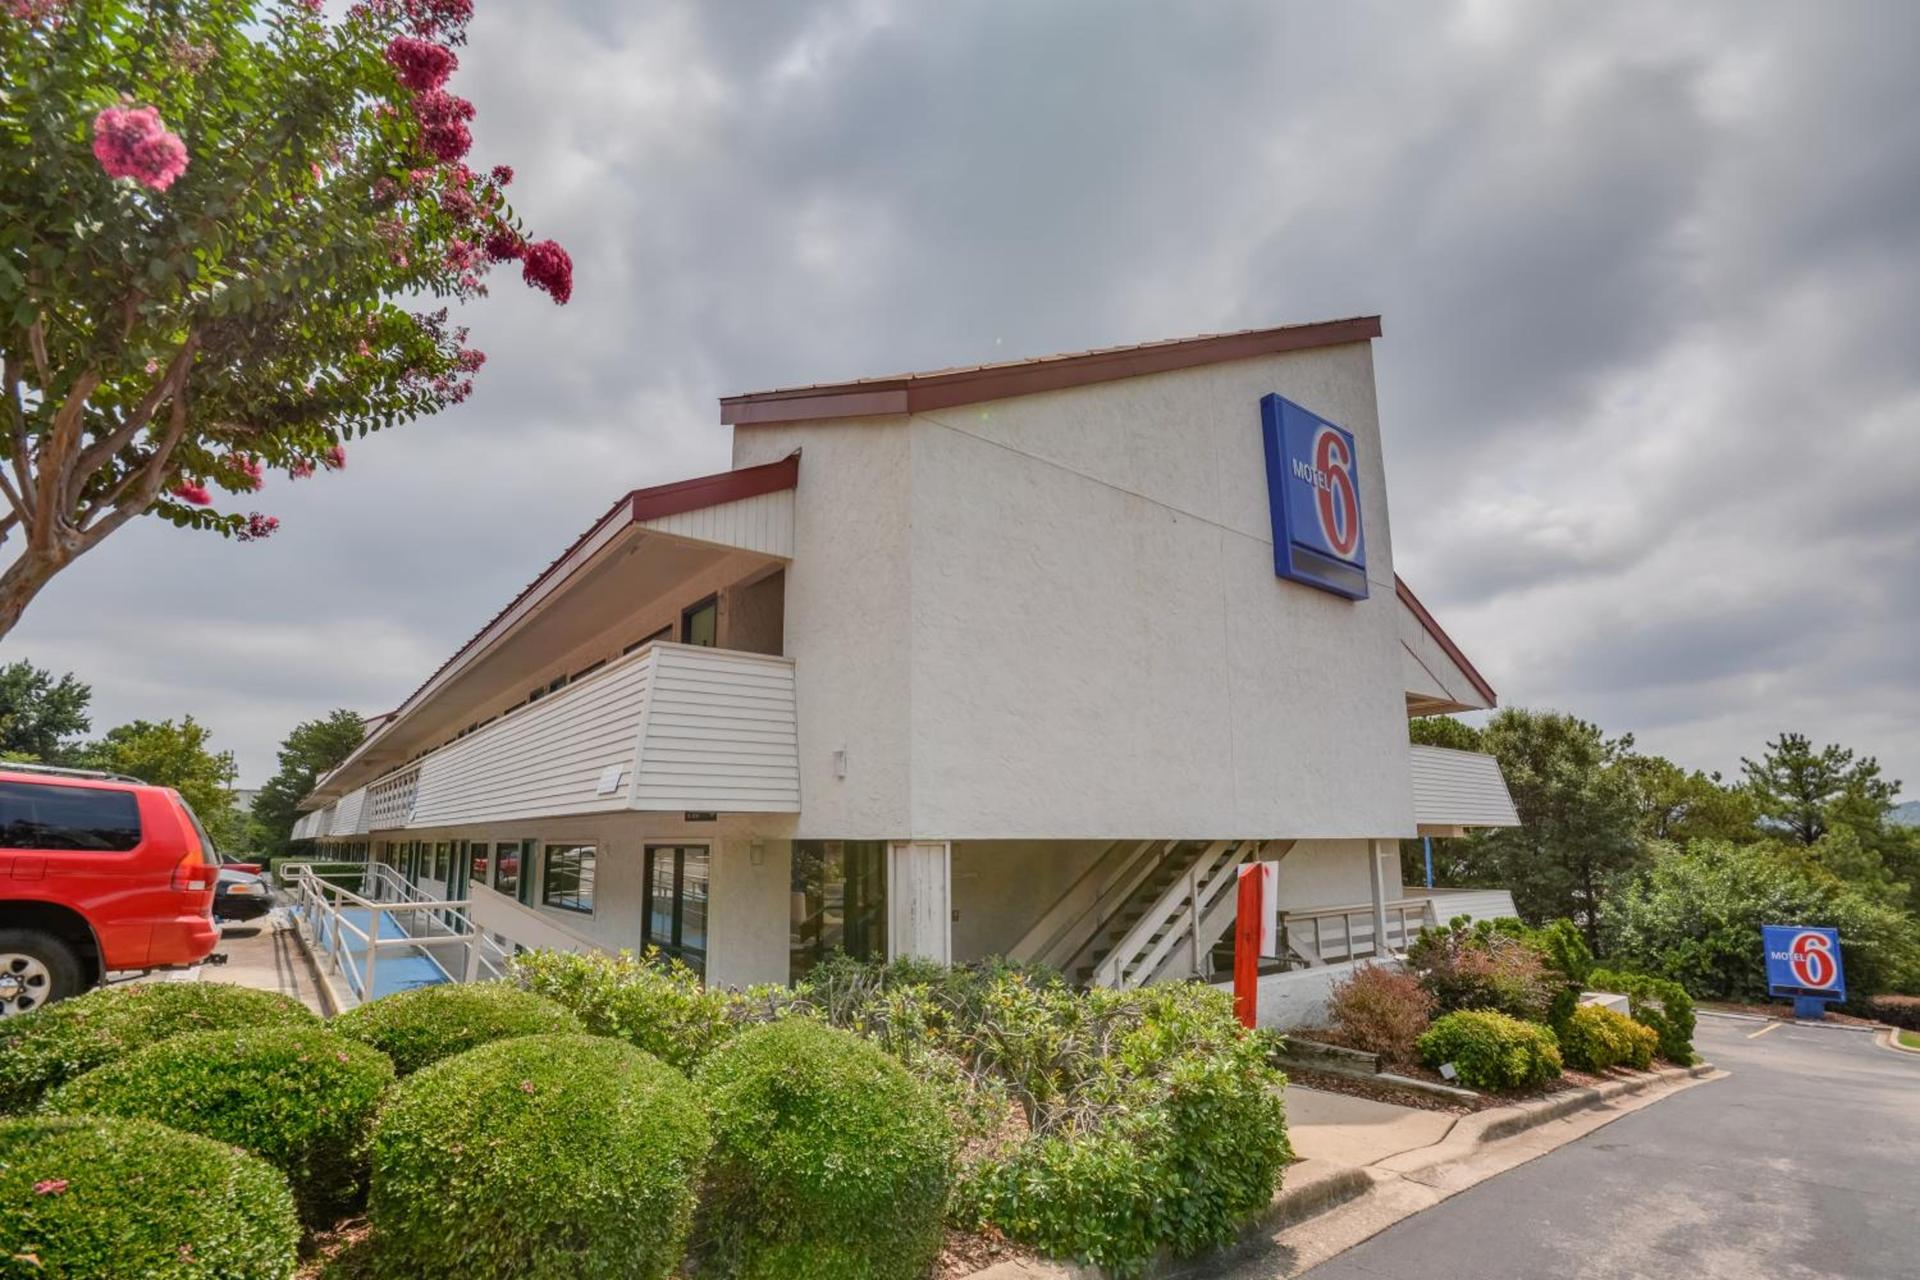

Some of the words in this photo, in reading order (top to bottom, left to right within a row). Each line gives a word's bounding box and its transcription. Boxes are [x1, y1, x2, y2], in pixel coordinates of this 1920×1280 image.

[1292, 457, 1330, 492] MOTEL
[1312, 427, 1359, 558] 6
[1771, 951, 1806, 962] MOTEL
[1790, 932, 1837, 989] 6
